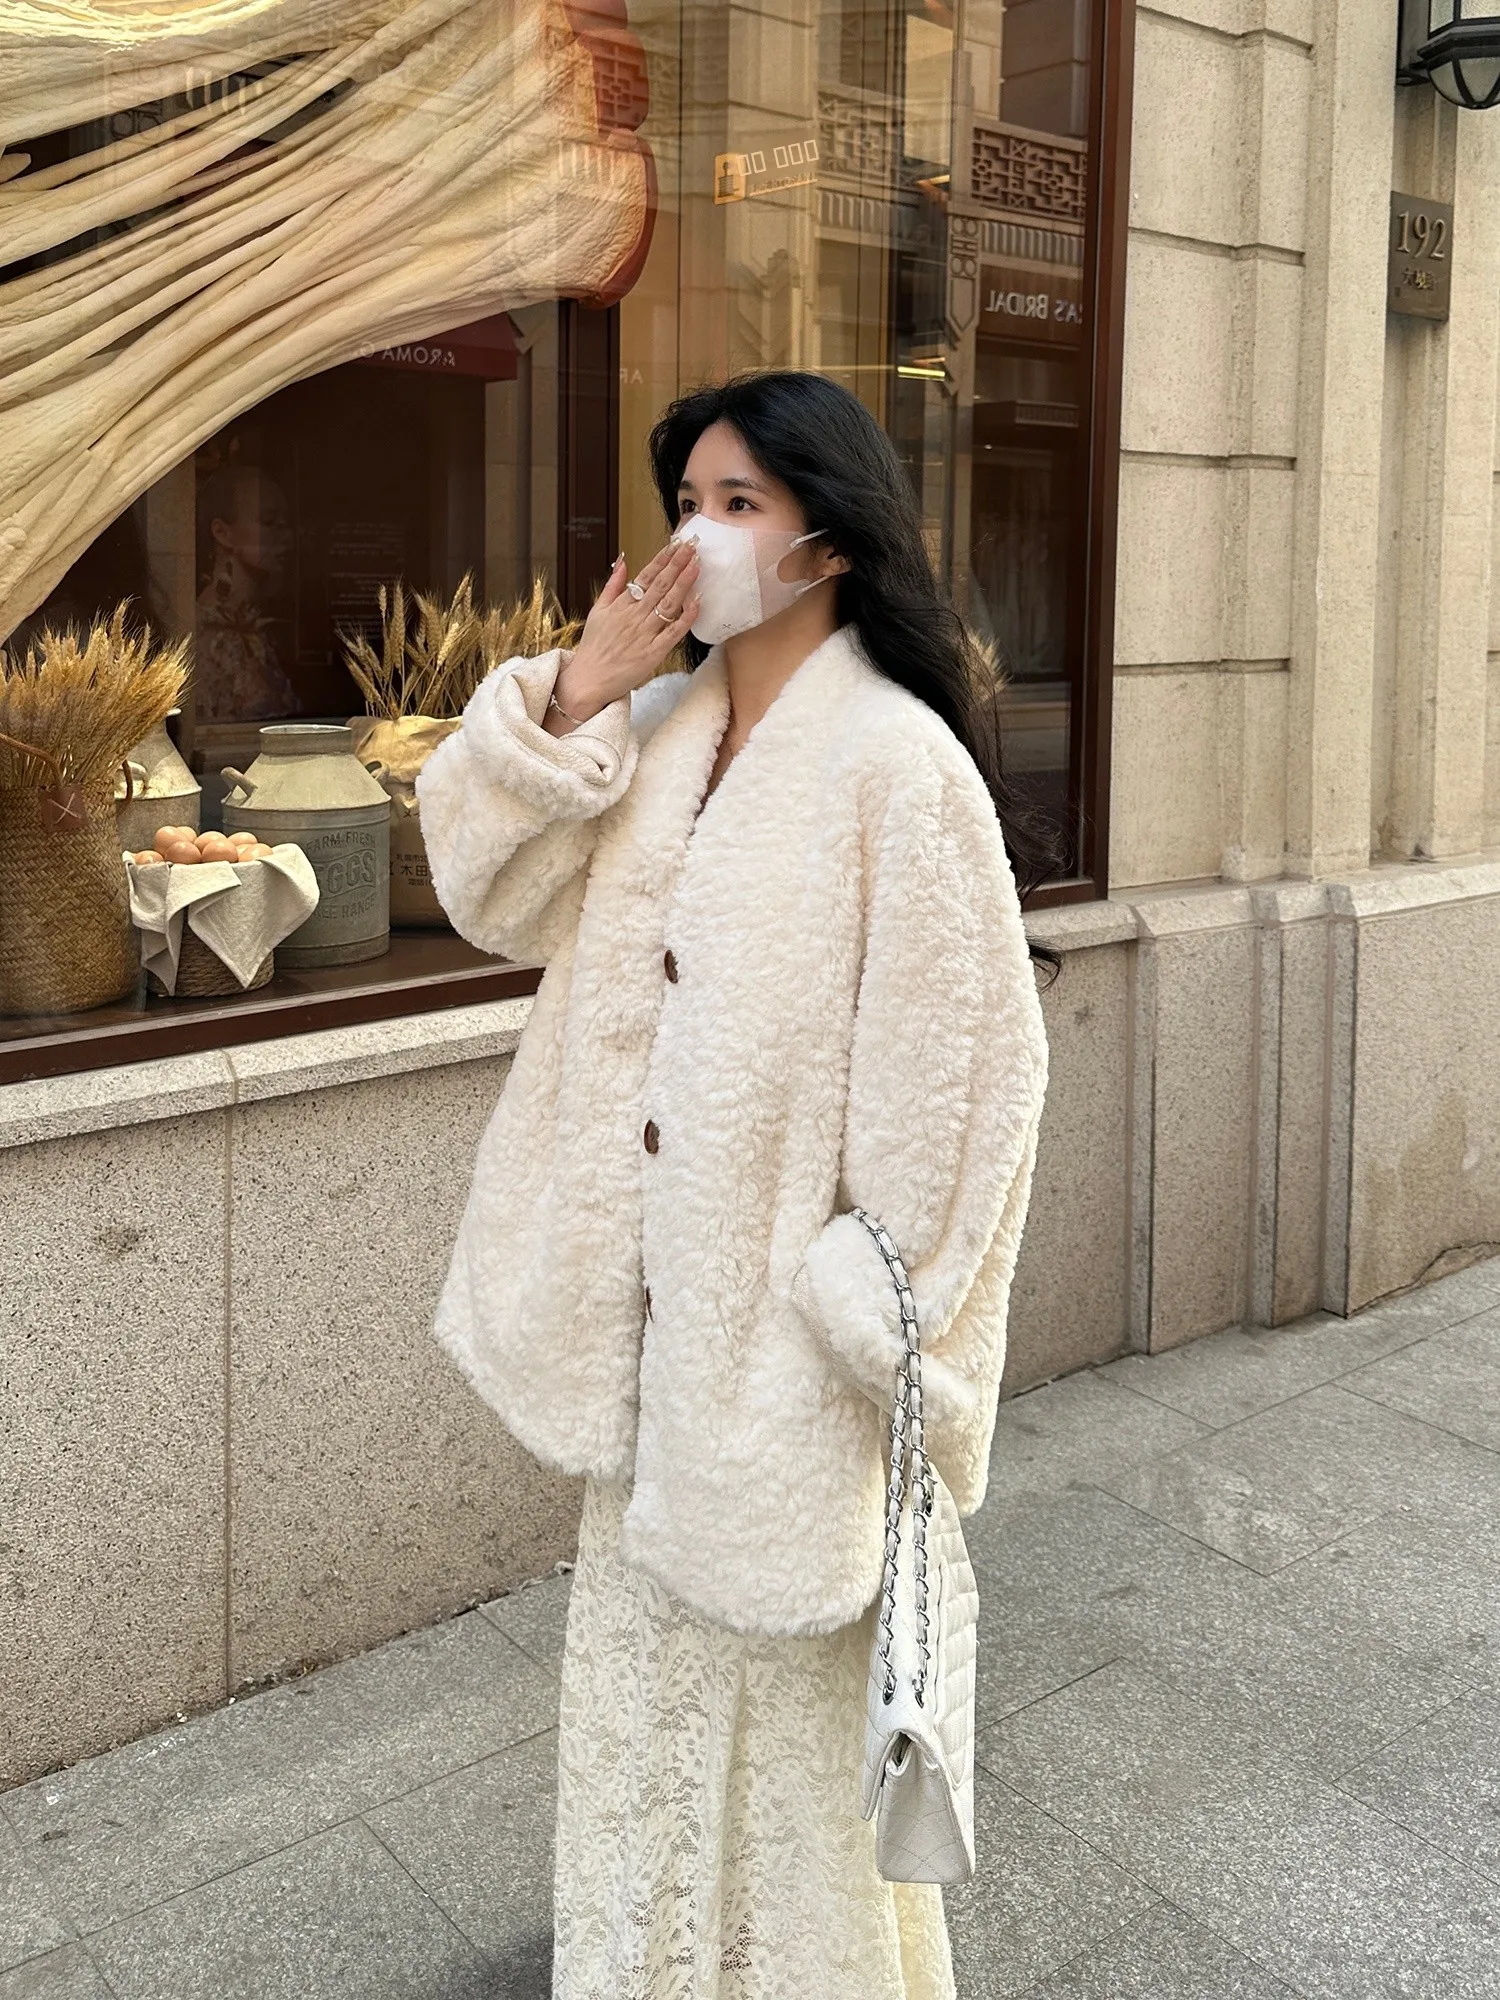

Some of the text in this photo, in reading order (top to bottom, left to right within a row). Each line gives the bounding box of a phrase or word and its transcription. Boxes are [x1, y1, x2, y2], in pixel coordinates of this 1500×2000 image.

[1396, 211, 1446, 261] 192
[306, 830, 377, 853] FARM FRESH
